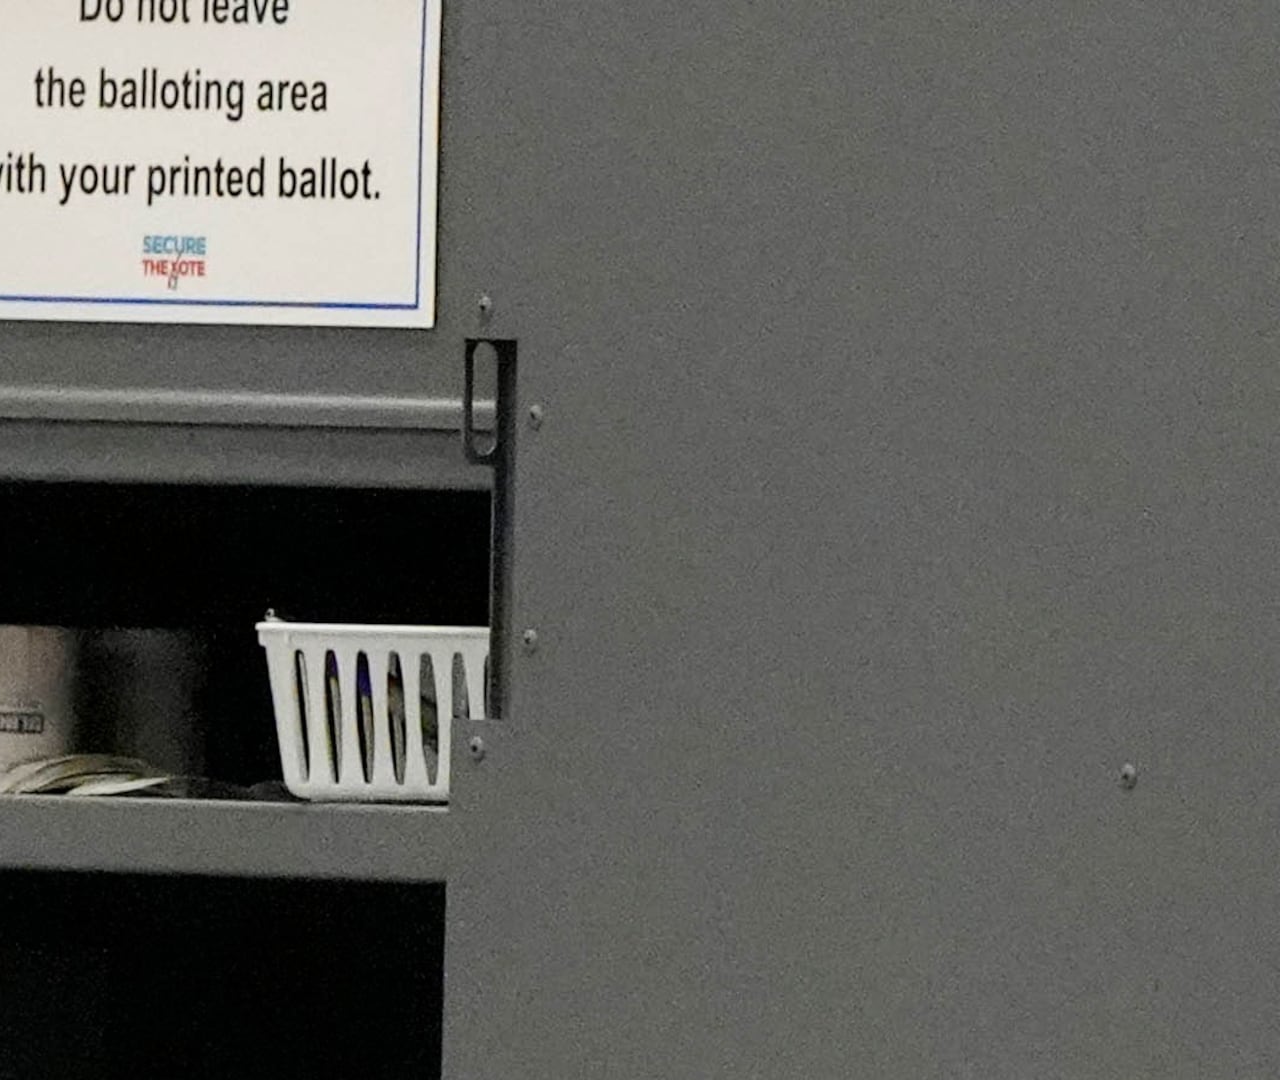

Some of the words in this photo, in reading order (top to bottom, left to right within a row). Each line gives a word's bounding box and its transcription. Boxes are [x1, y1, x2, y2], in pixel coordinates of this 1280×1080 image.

[80, 0, 123, 23] Do
[138, 0, 190, 24] not
[203, 0, 289, 24] leave
[35, 66, 86, 108] the
[99, 68, 244, 121] balloting
[257, 80, 328, 112] area
[59, 163, 136, 206] your
[148, 155, 265, 206] printed
[278, 157, 381, 200] ballot.
[143, 235, 206, 255] SECURE
[143, 259, 168, 276] THE
